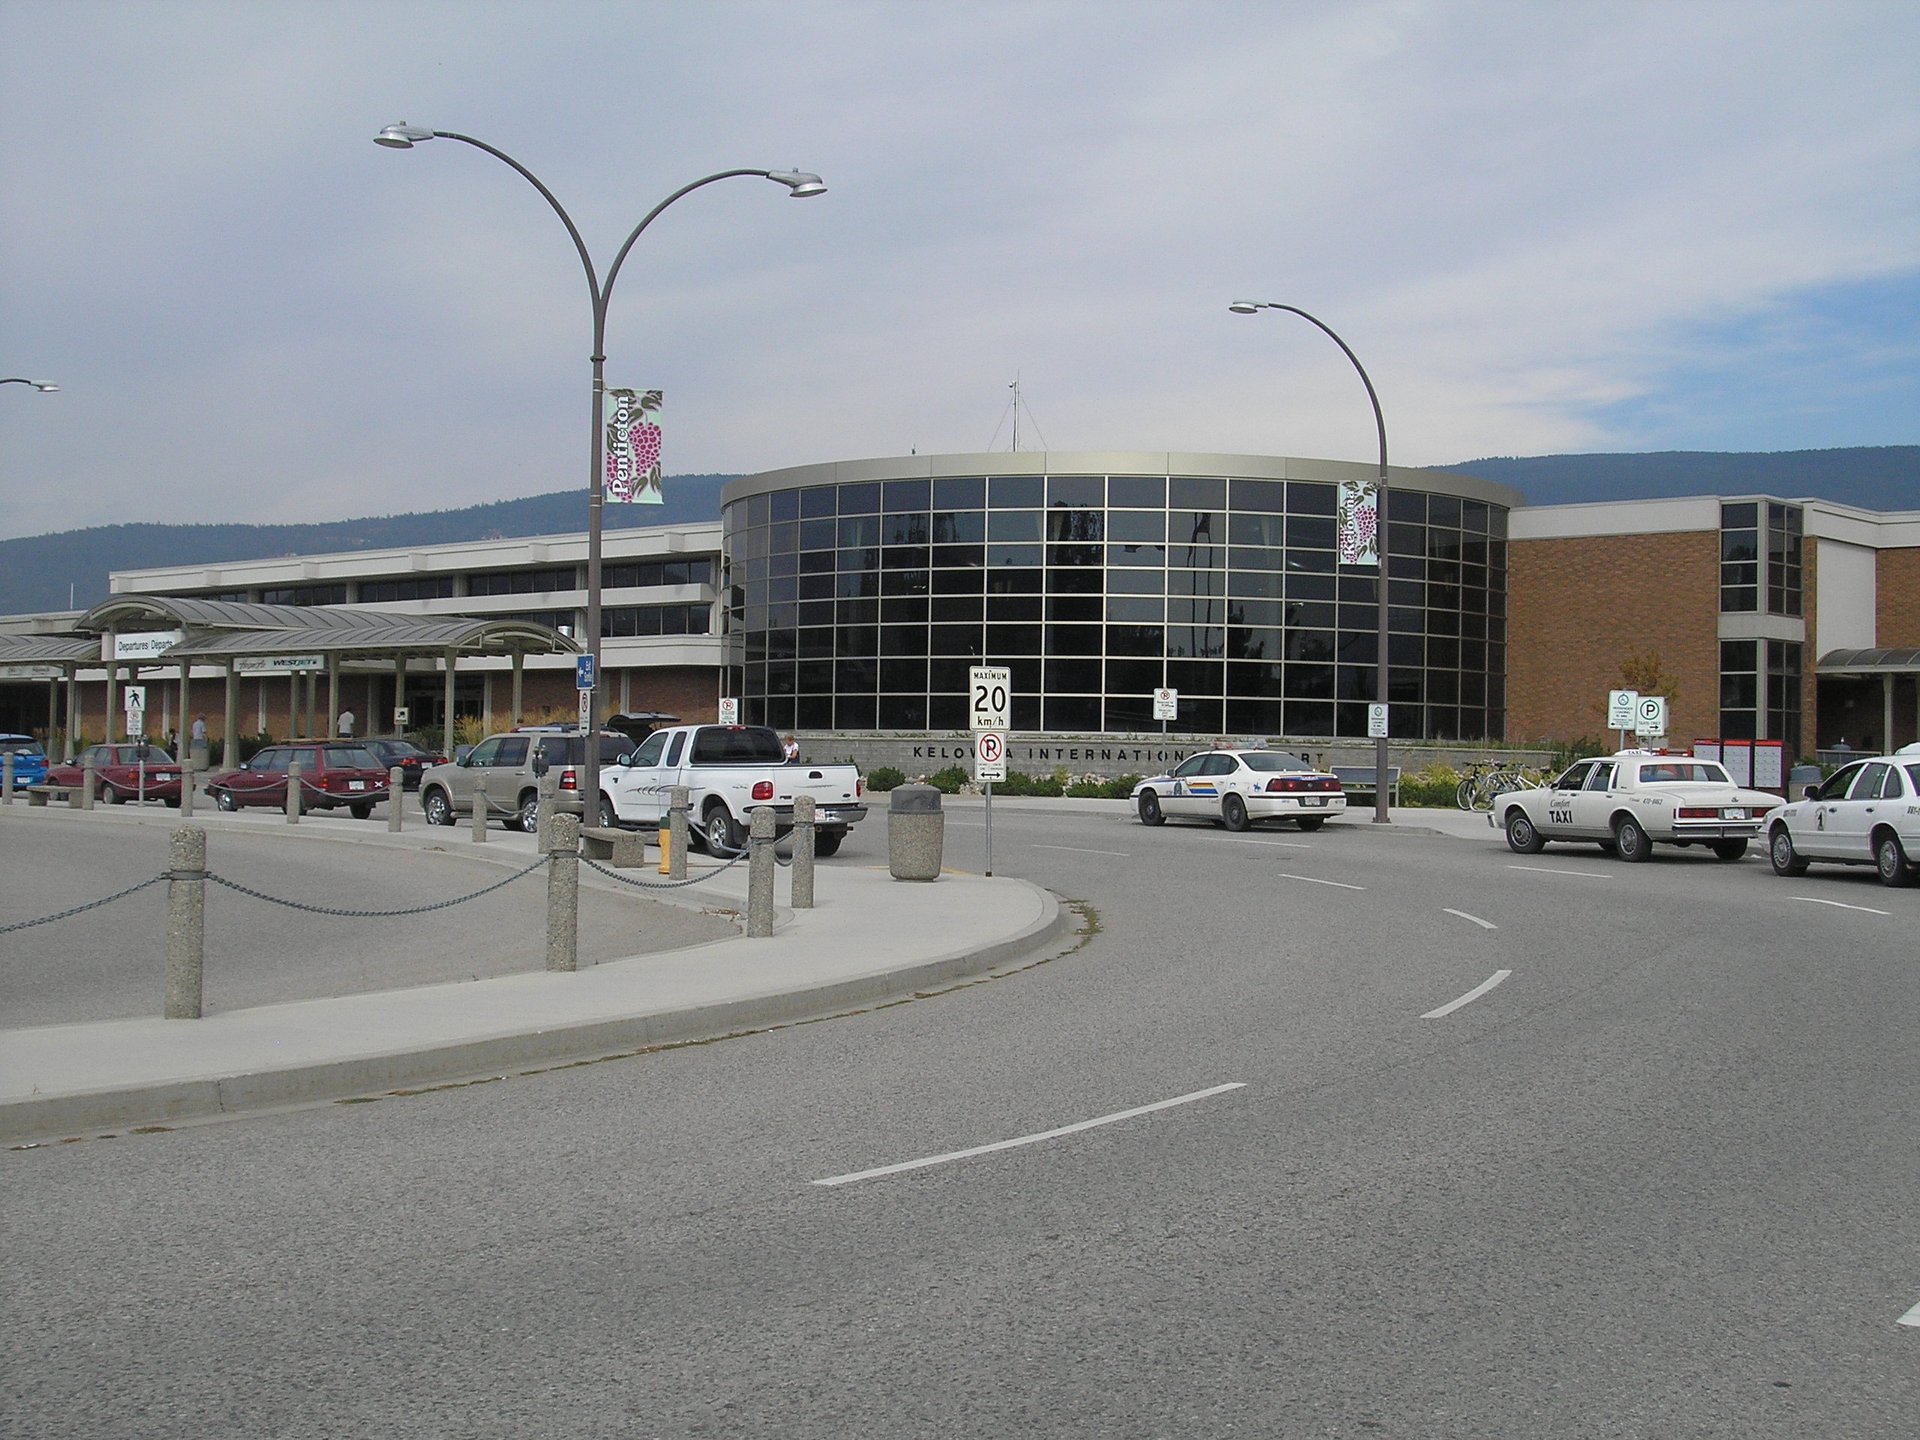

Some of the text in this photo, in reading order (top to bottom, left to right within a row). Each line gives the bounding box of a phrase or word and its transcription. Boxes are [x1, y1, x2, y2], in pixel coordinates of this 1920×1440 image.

[612, 396, 629, 494] Penticton
[1343, 490, 1357, 557] Kelowna
[118, 641, 149, 653] Departures
[973, 671, 1007, 680] MAXIMUM
[974, 685, 1006, 713] 20
[1646, 704, 1656, 717] P
[977, 715, 1004, 726] km/h
[913, 746, 1013, 759] KELOA
[1550, 798, 1571, 810] Comfort
[1548, 810, 1573, 824] TAXI
